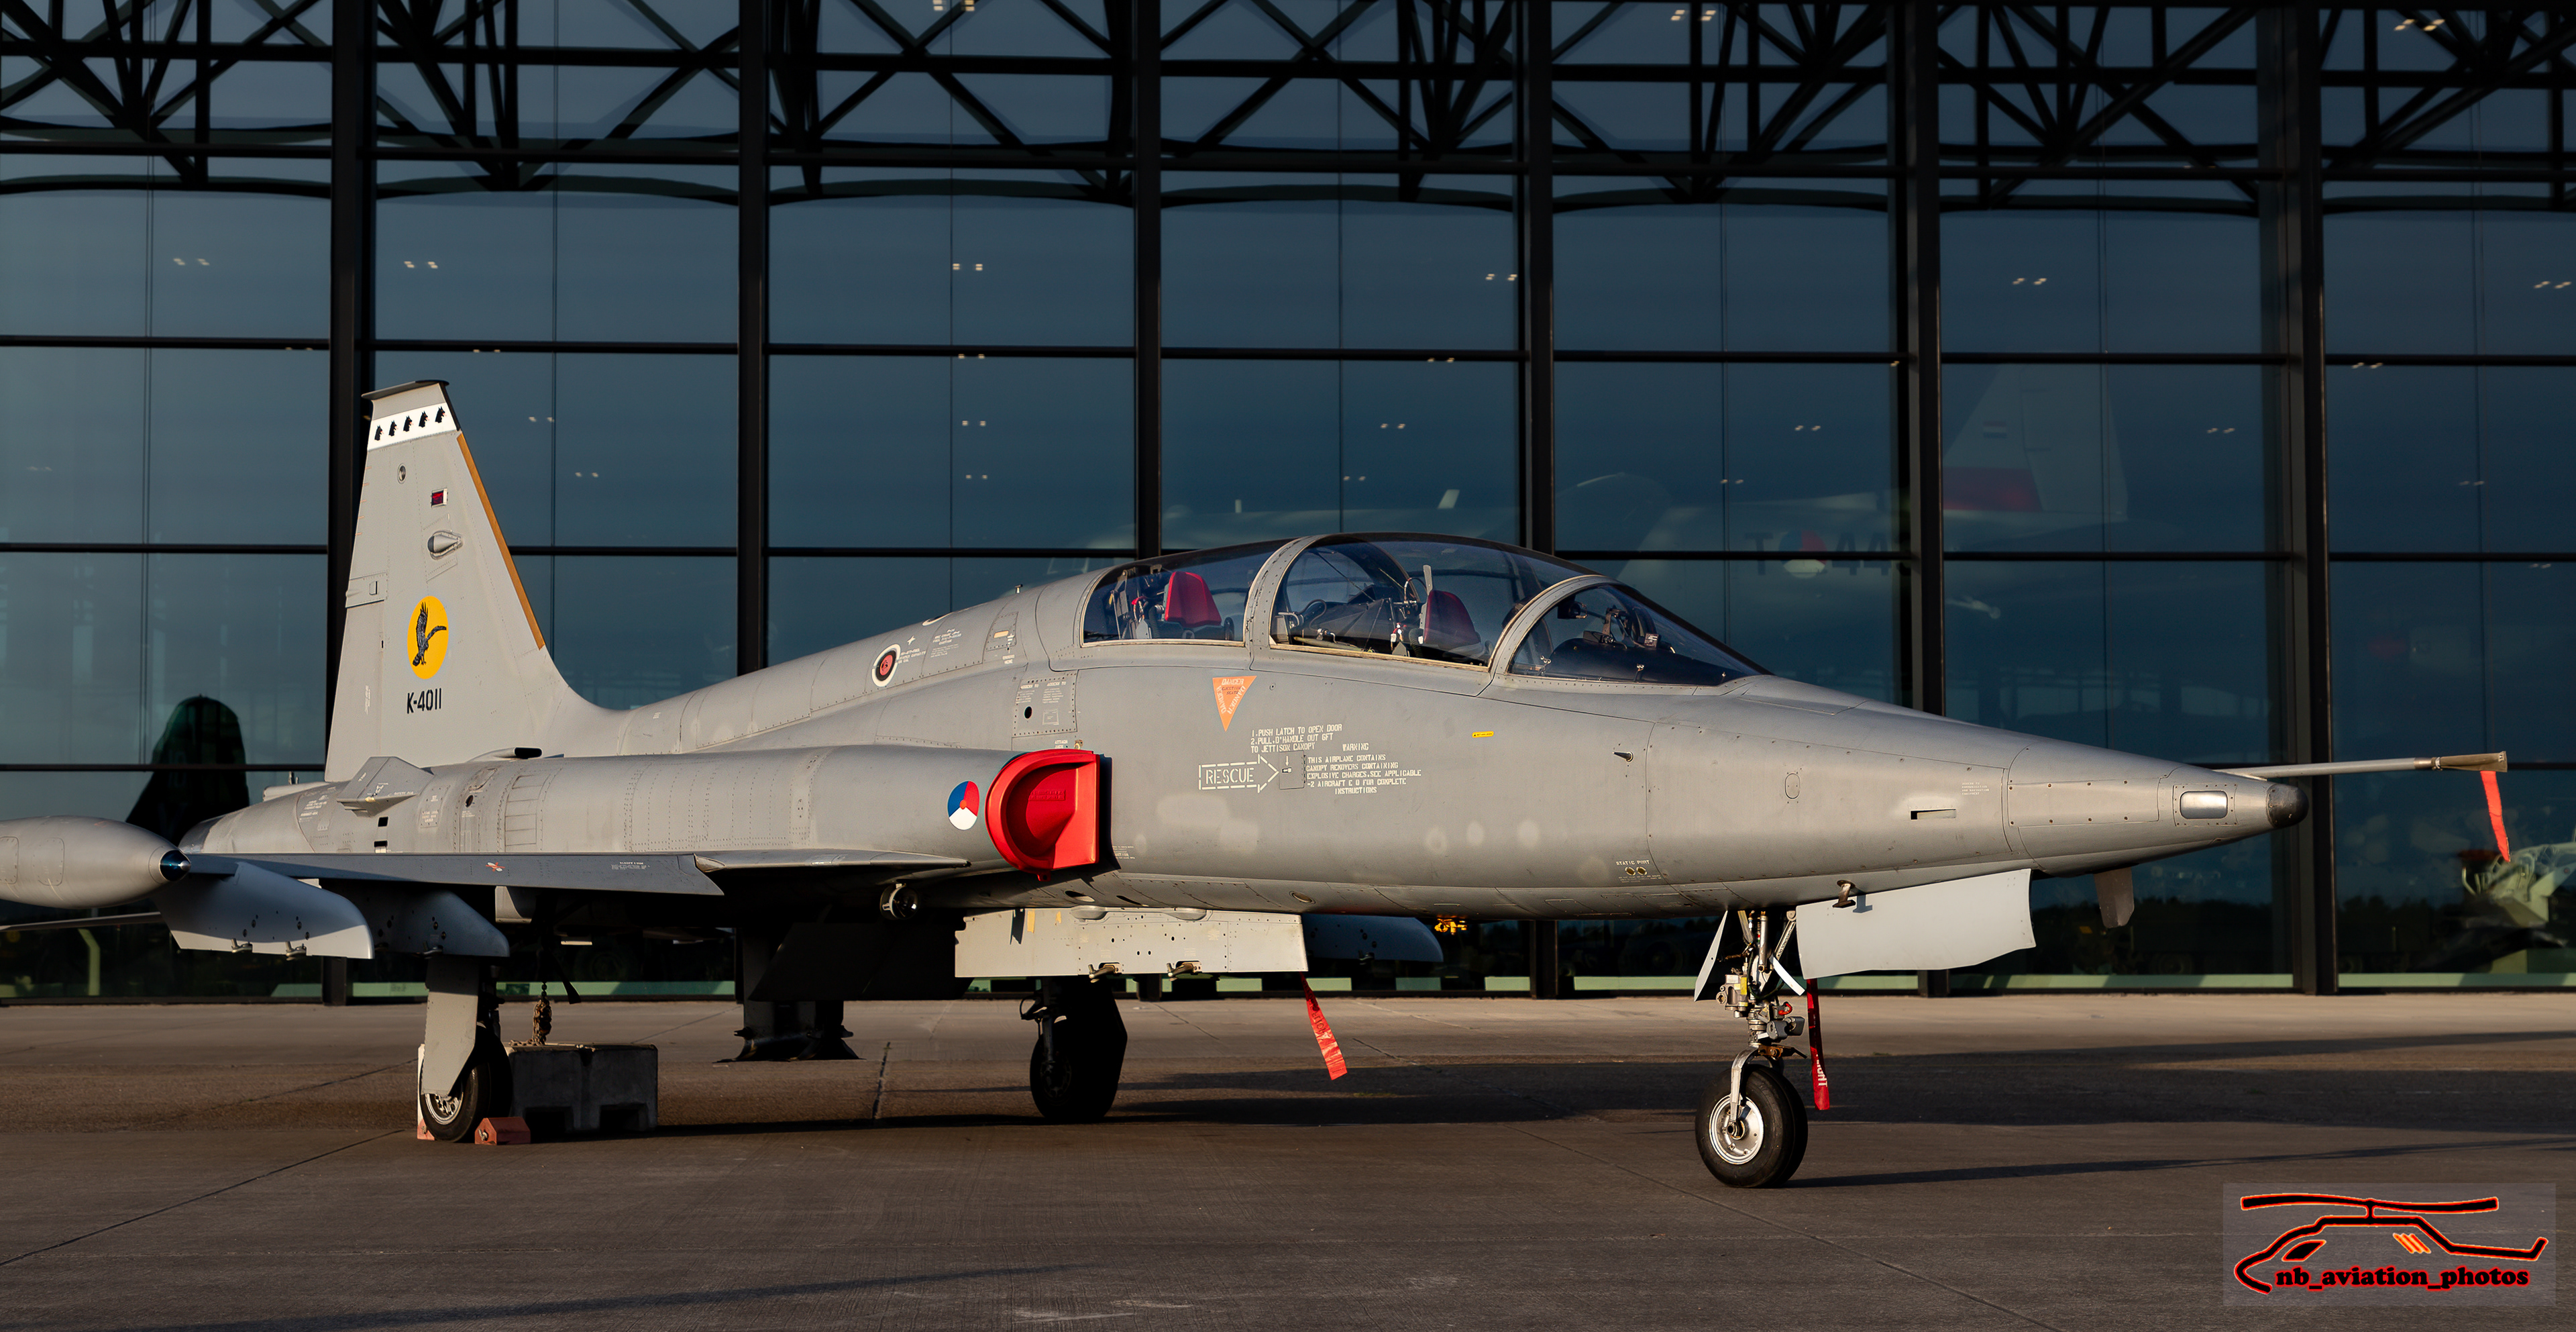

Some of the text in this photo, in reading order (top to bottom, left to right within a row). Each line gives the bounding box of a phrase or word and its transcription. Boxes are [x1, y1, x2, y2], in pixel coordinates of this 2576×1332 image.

[407, 688, 441, 714] K-4011
[1216, 685, 1227, 714] DANGER
[1227, 685, 1246, 715] DANGER
[1276, 727, 1295, 735] LATCH
[1298, 726, 1305, 734] TO
[1308, 725, 1324, 733] OPEN
[1327, 723, 1342, 732] DOOR
[1307, 733, 1319, 741] OUT
[1261, 744, 1291, 753] JETTISON
[1293, 742, 1316, 751] CANOPY
[1342, 743, 1368, 752] WARNING
[1205, 768, 1254, 784] RESCUE
[1335, 786, 1377, 795] INSTRUCTIONS
